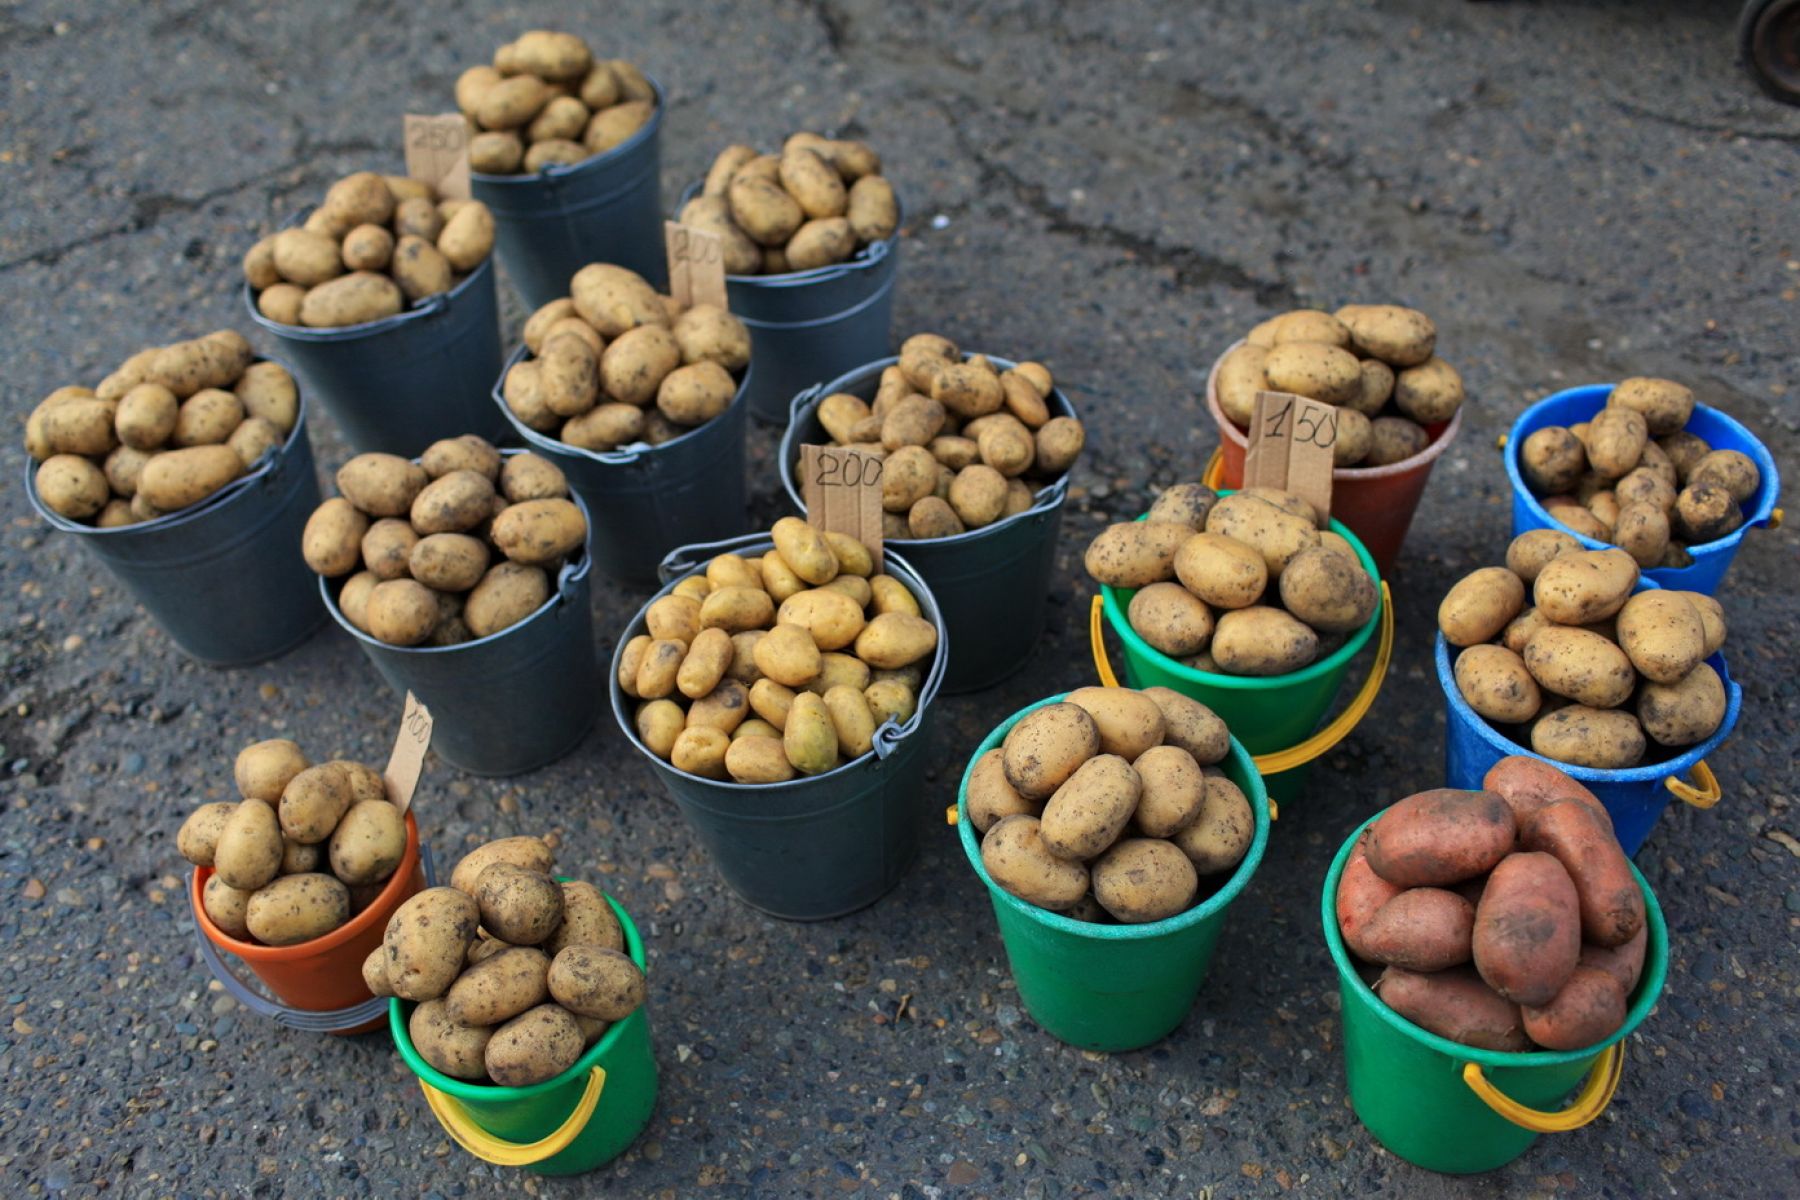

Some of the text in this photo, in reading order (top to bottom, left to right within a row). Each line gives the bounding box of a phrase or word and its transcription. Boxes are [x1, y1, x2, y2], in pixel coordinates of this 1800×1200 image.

[673, 229, 721, 265] 200
[1264, 400, 1337, 448] 150
[816, 452, 883, 487] 200
[407, 710, 430, 743] 100
